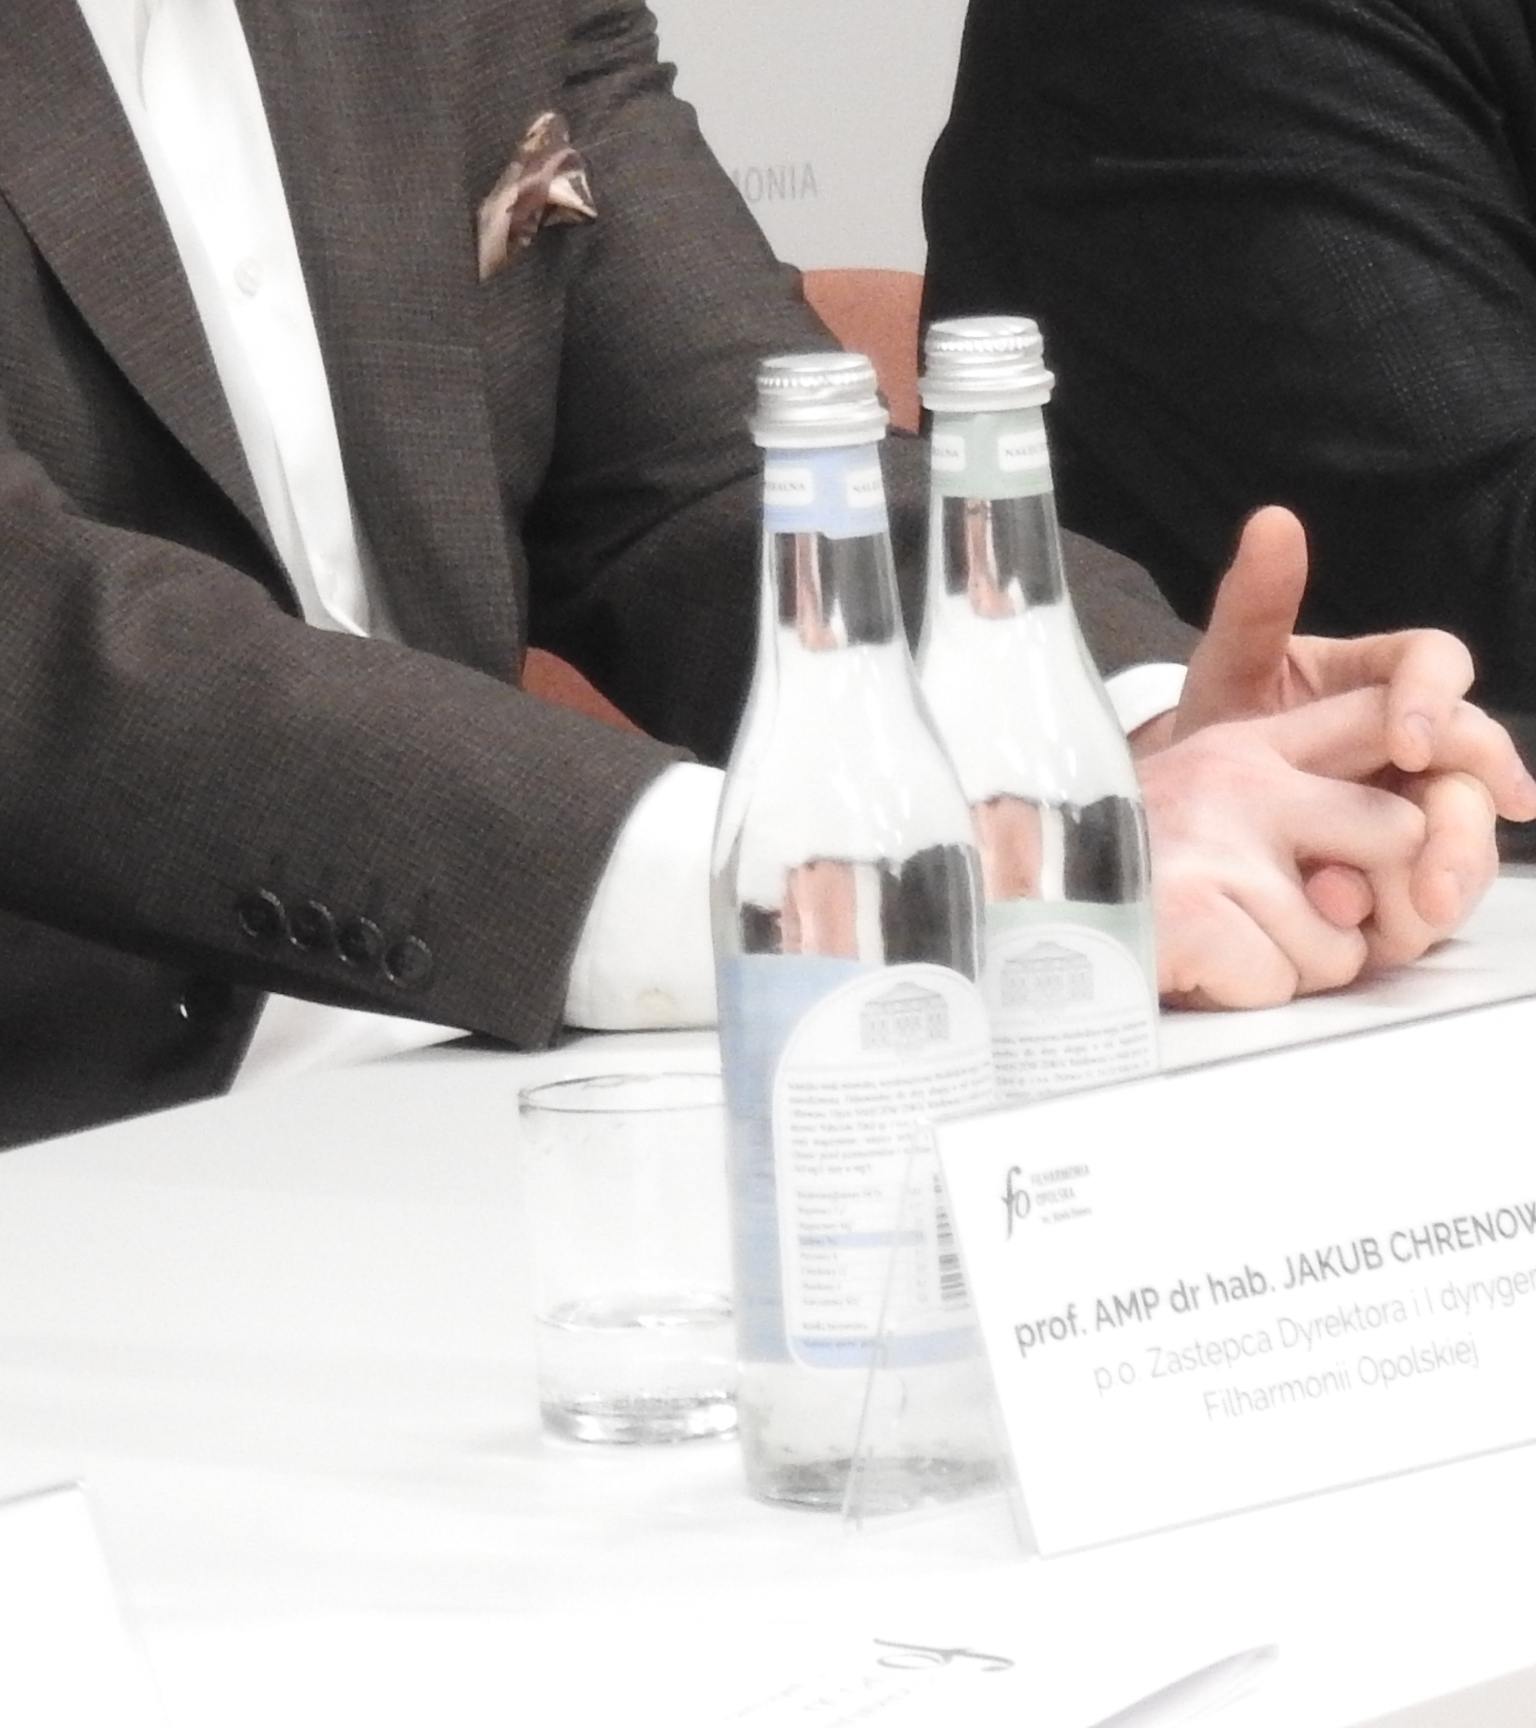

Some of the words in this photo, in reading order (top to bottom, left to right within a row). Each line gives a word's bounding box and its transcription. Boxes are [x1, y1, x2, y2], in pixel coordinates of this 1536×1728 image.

[1013, 1303, 1088, 1359] prof.
[1093, 1287, 1161, 1333] AMP
[1169, 1279, 1201, 1315] dr
[1207, 1264, 1277, 1307] hab.
[1282, 1237, 1385, 1292] JAKUB
[1275, 1296, 1408, 1353] Dyrektora
[1202, 1367, 1353, 1424] Filharmonii
[1356, 1331, 1482, 1389] Opolskiej
